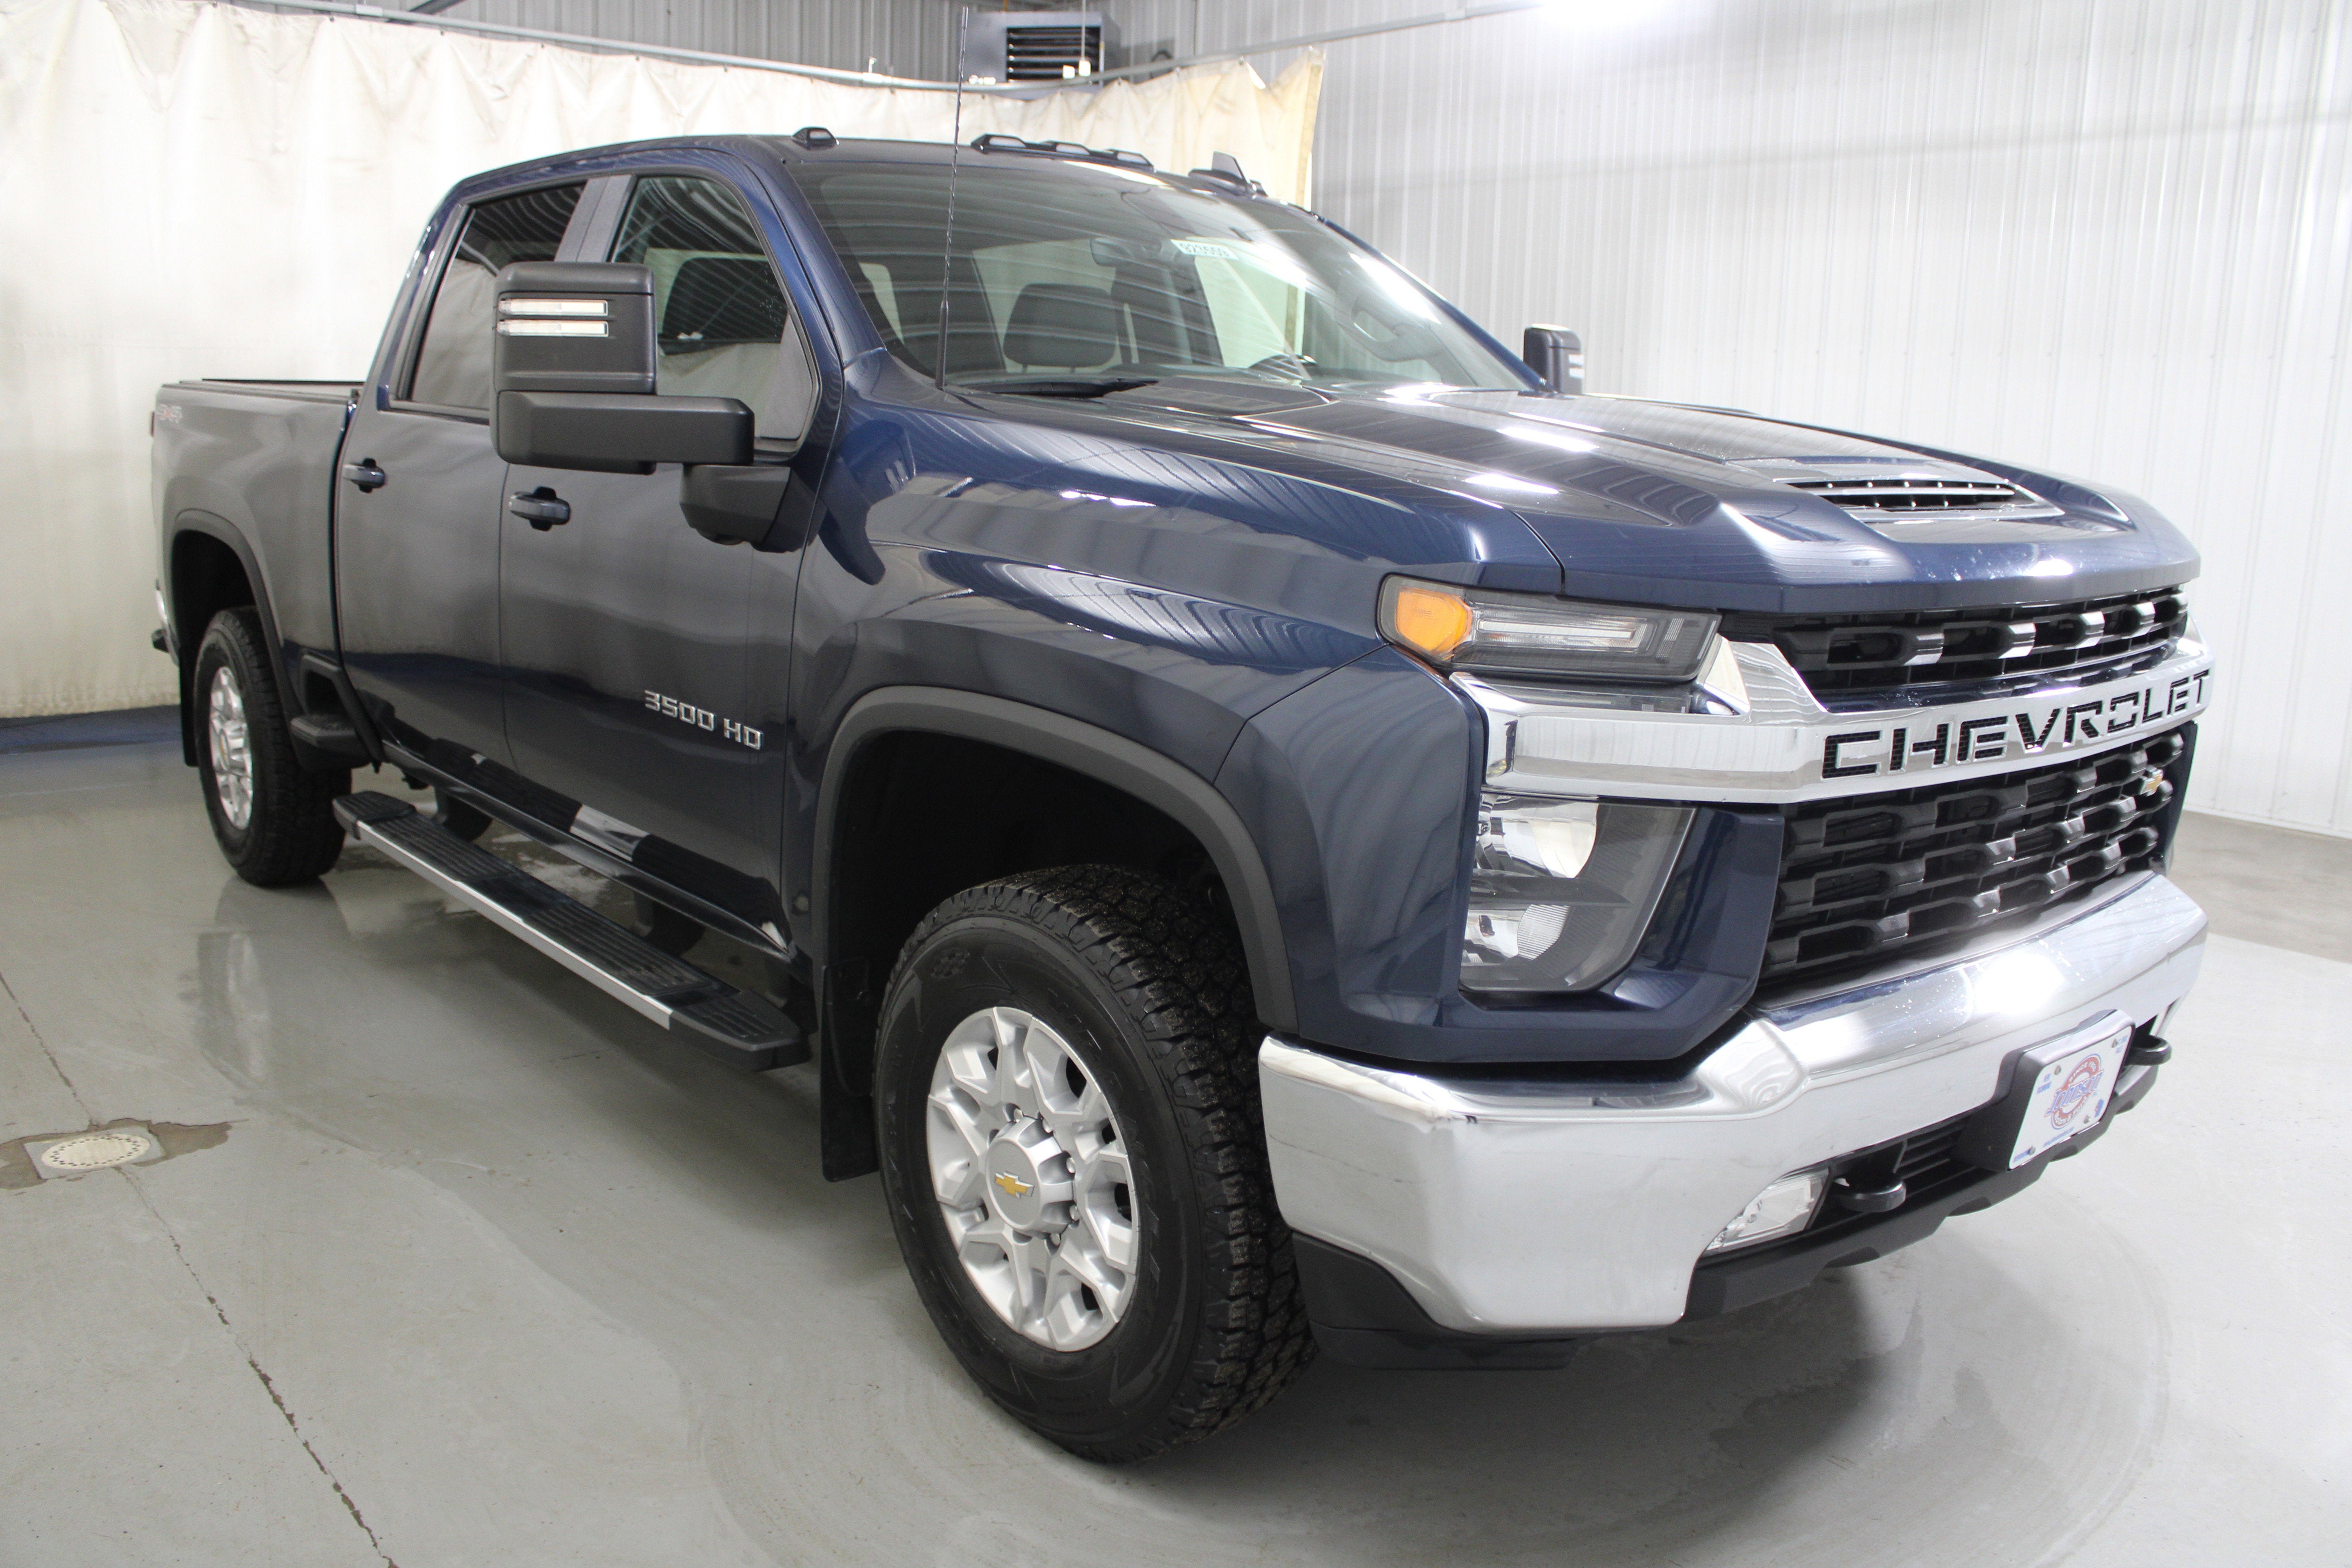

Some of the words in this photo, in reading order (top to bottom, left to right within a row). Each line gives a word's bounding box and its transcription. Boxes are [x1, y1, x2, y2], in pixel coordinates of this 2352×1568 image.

[644, 690, 716, 731] 3500
[723, 718, 764, 750] HD
[1822, 669, 2209, 780] CHEVROLET
[2045, 1069, 2104, 1117] Johnson
